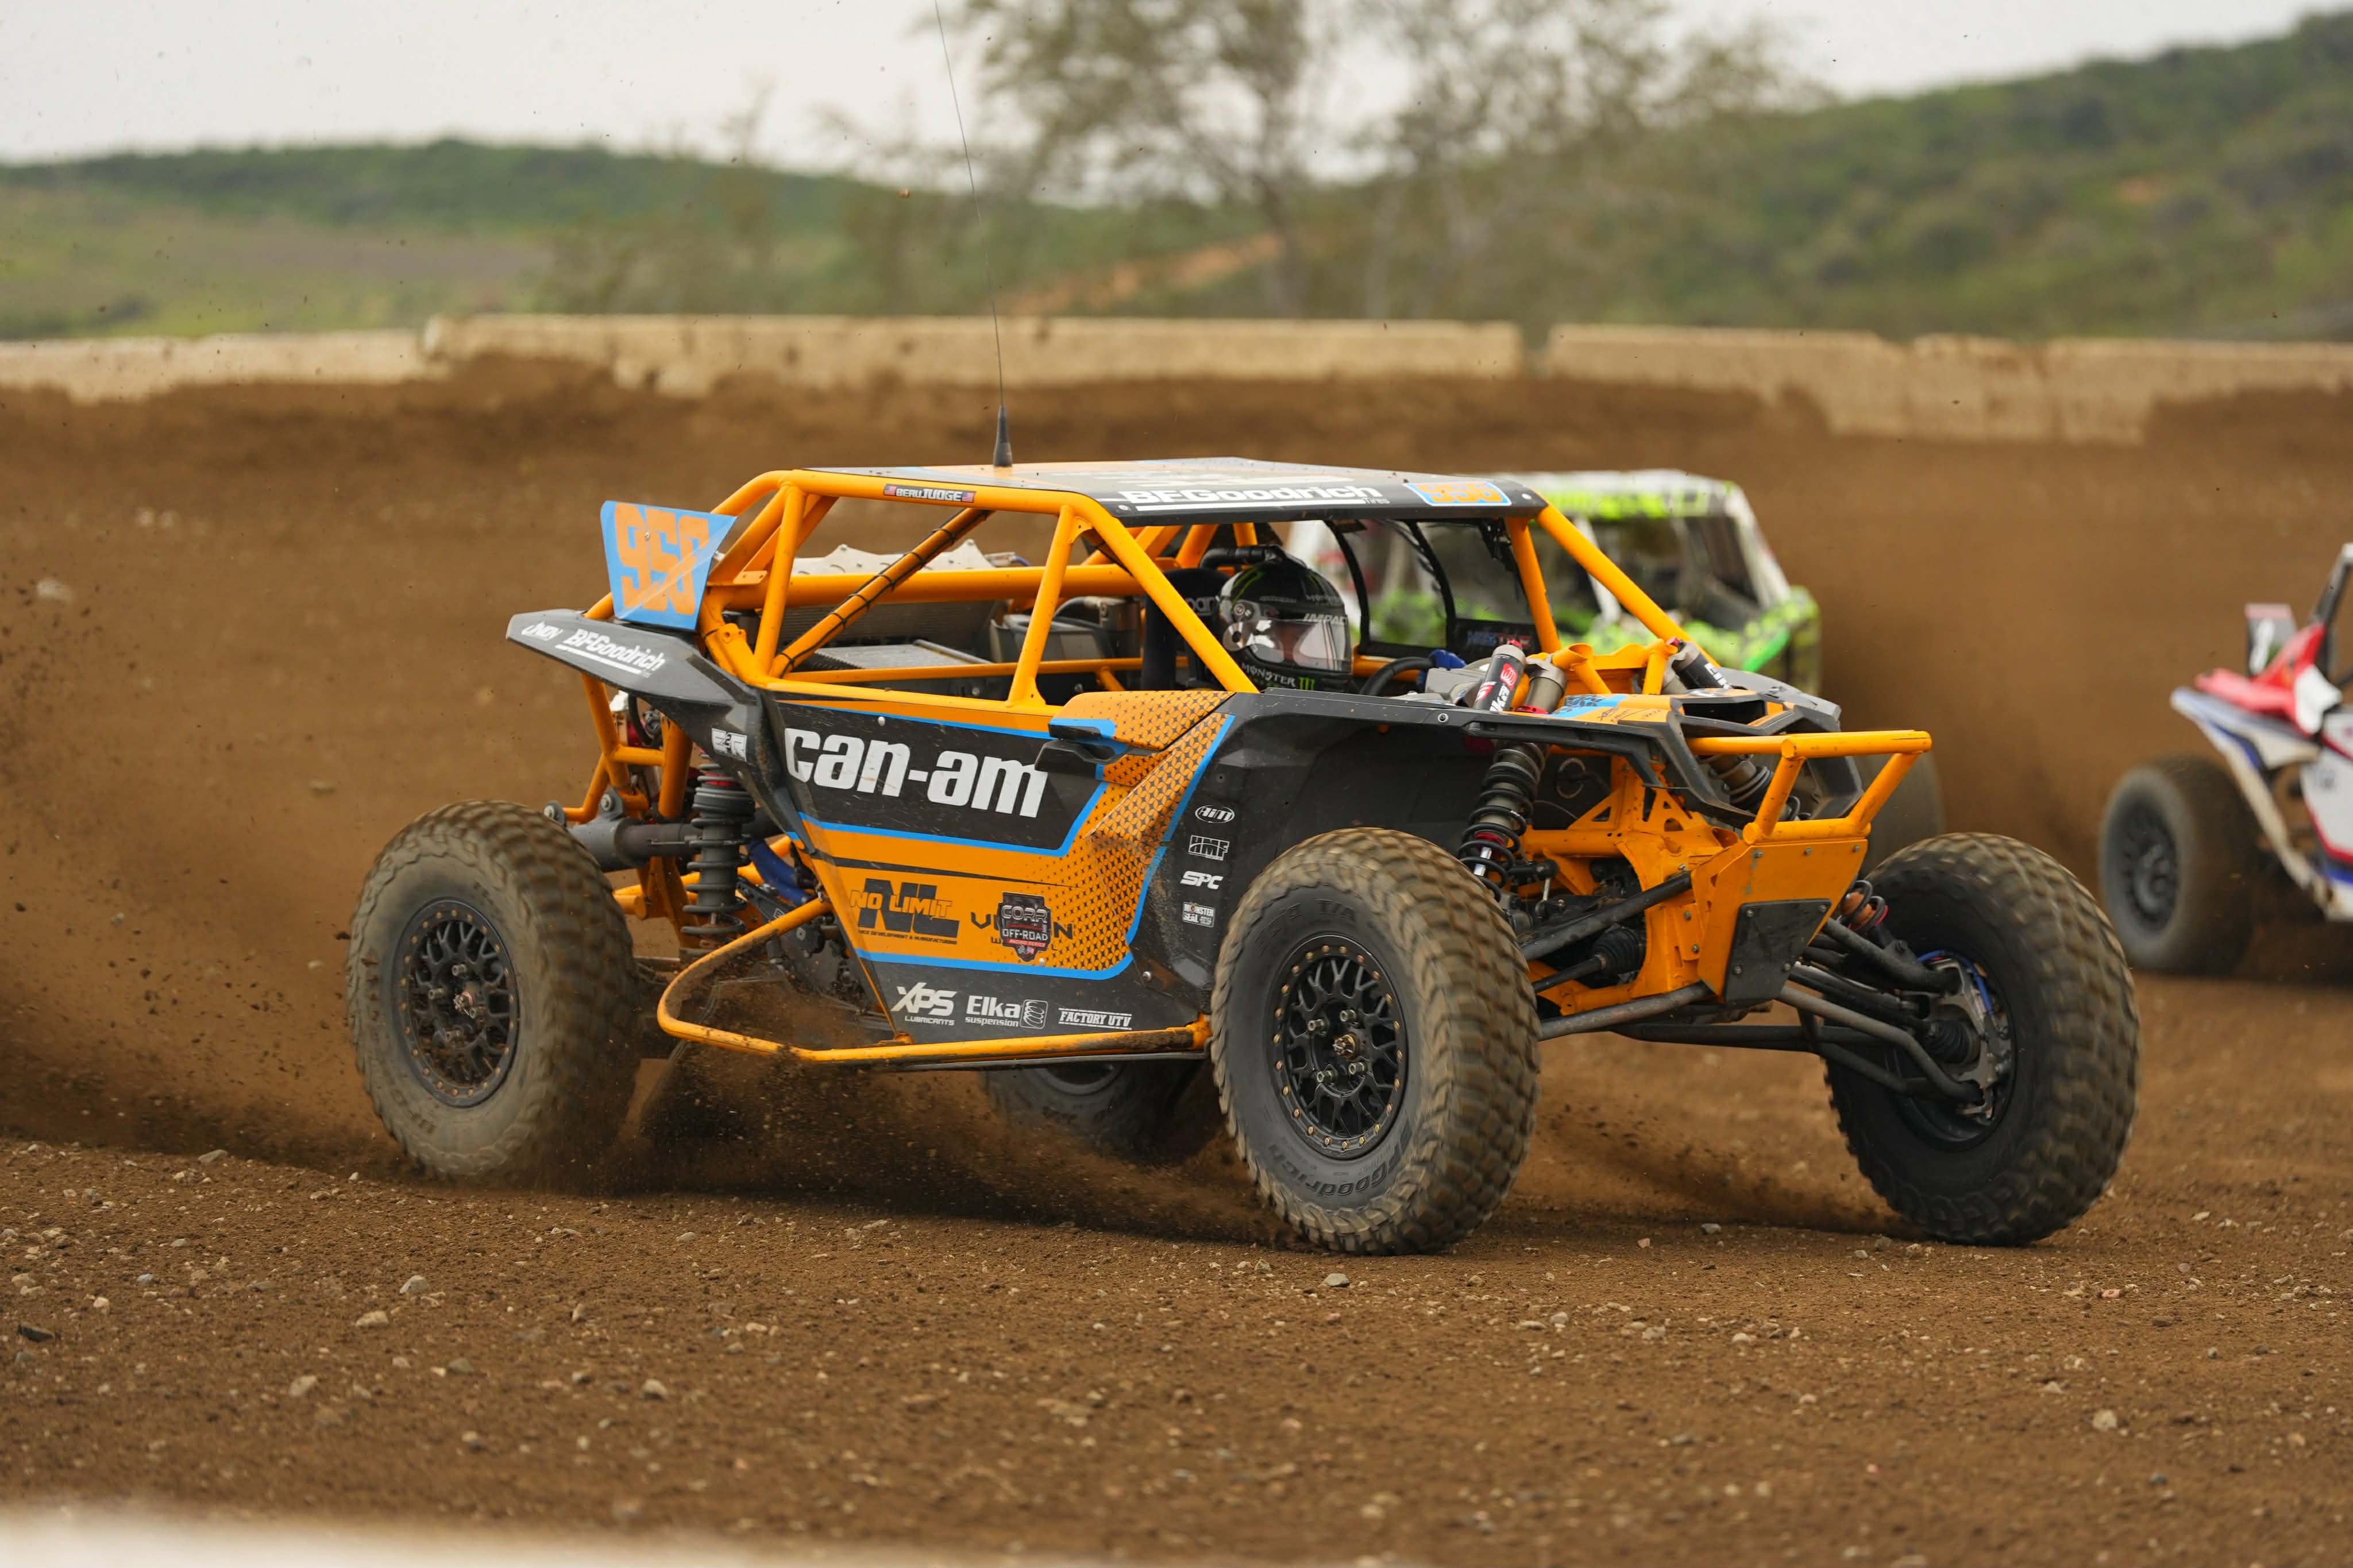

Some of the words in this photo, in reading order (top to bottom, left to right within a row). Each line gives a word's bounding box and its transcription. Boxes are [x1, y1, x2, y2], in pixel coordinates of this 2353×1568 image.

[923, 488, 963, 501] JUDGE
[1118, 486, 1383, 504] BFGoodrich
[1363, 496, 1390, 505] Tires
[1415, 481, 1503, 502] 956
[614, 501, 709, 616] 956
[562, 628, 666, 671] BFGoodrich
[1241, 662, 1297, 688] MONSTER
[784, 727, 1048, 818] can-am
[1187, 835, 1230, 859] HMF
[1179, 870, 1224, 890] SPC
[850, 890, 884, 910] NO
[889, 894, 953, 918] LIMIT
[1183, 902, 1214, 917] MNSTER
[1001, 905, 1048, 924] CORR
[1002, 928, 1048, 941] OFF-ROAD
[890, 982, 958, 1017] XPS
[966, 995, 1021, 1018] Elka
[904, 1015, 955, 1026] LUBRICANTS
[965, 1016, 1019, 1027] suspension
[1059, 1010, 1106, 1025] FACTORY
[1108, 1015, 1132, 1027] UTV
